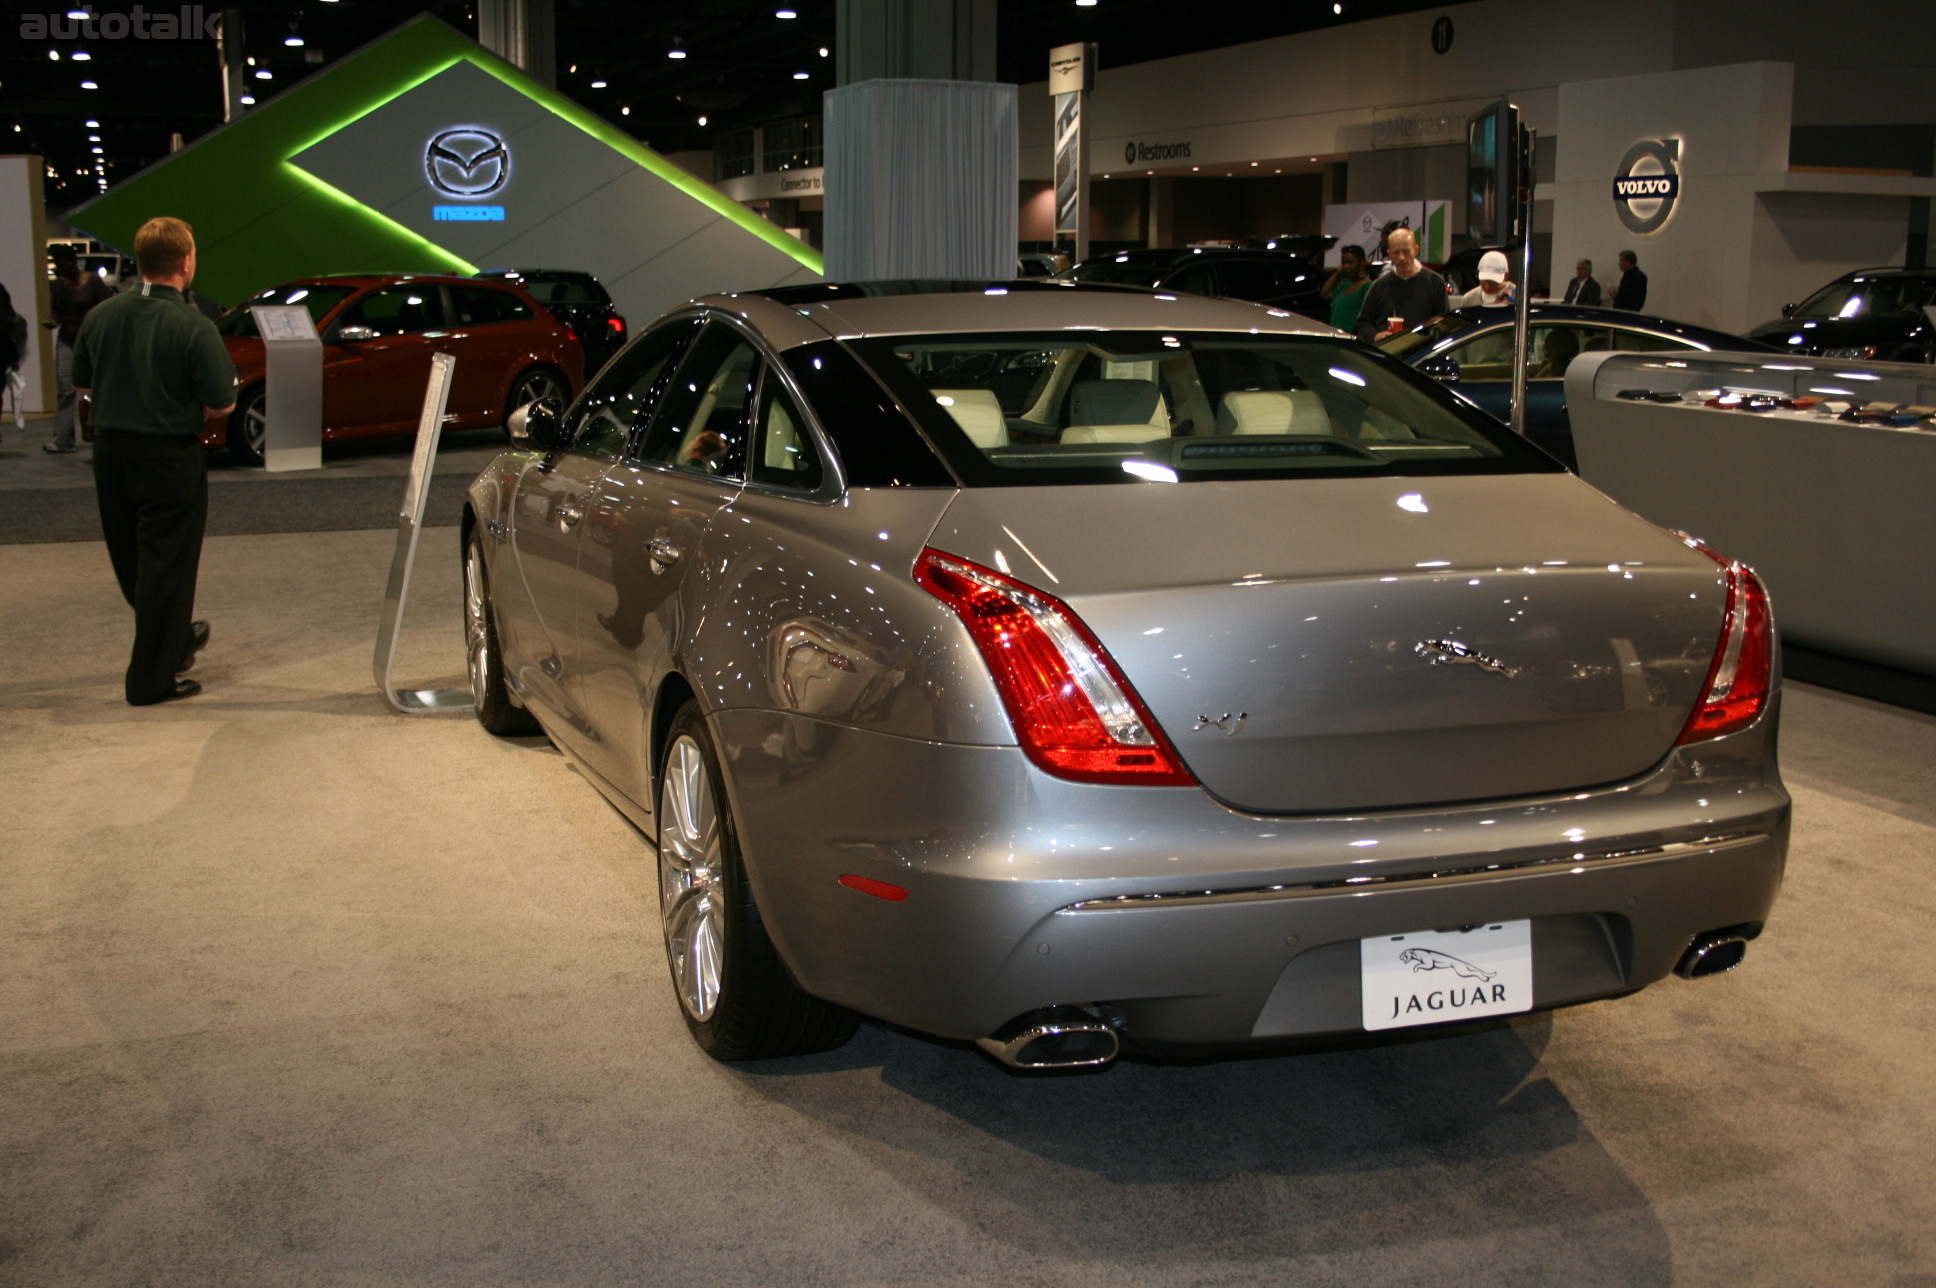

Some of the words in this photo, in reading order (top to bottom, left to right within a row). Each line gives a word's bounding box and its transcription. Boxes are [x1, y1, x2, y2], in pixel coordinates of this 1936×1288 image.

[1396, 110, 1467, 137] Refreshm
[1138, 142, 1191, 161] Restrooms
[781, 177, 812, 191] Connector
[813, 176, 821, 189] to
[1616, 180, 1671, 195] VOLVO
[1391, 983, 1506, 1019] JAGUAR
